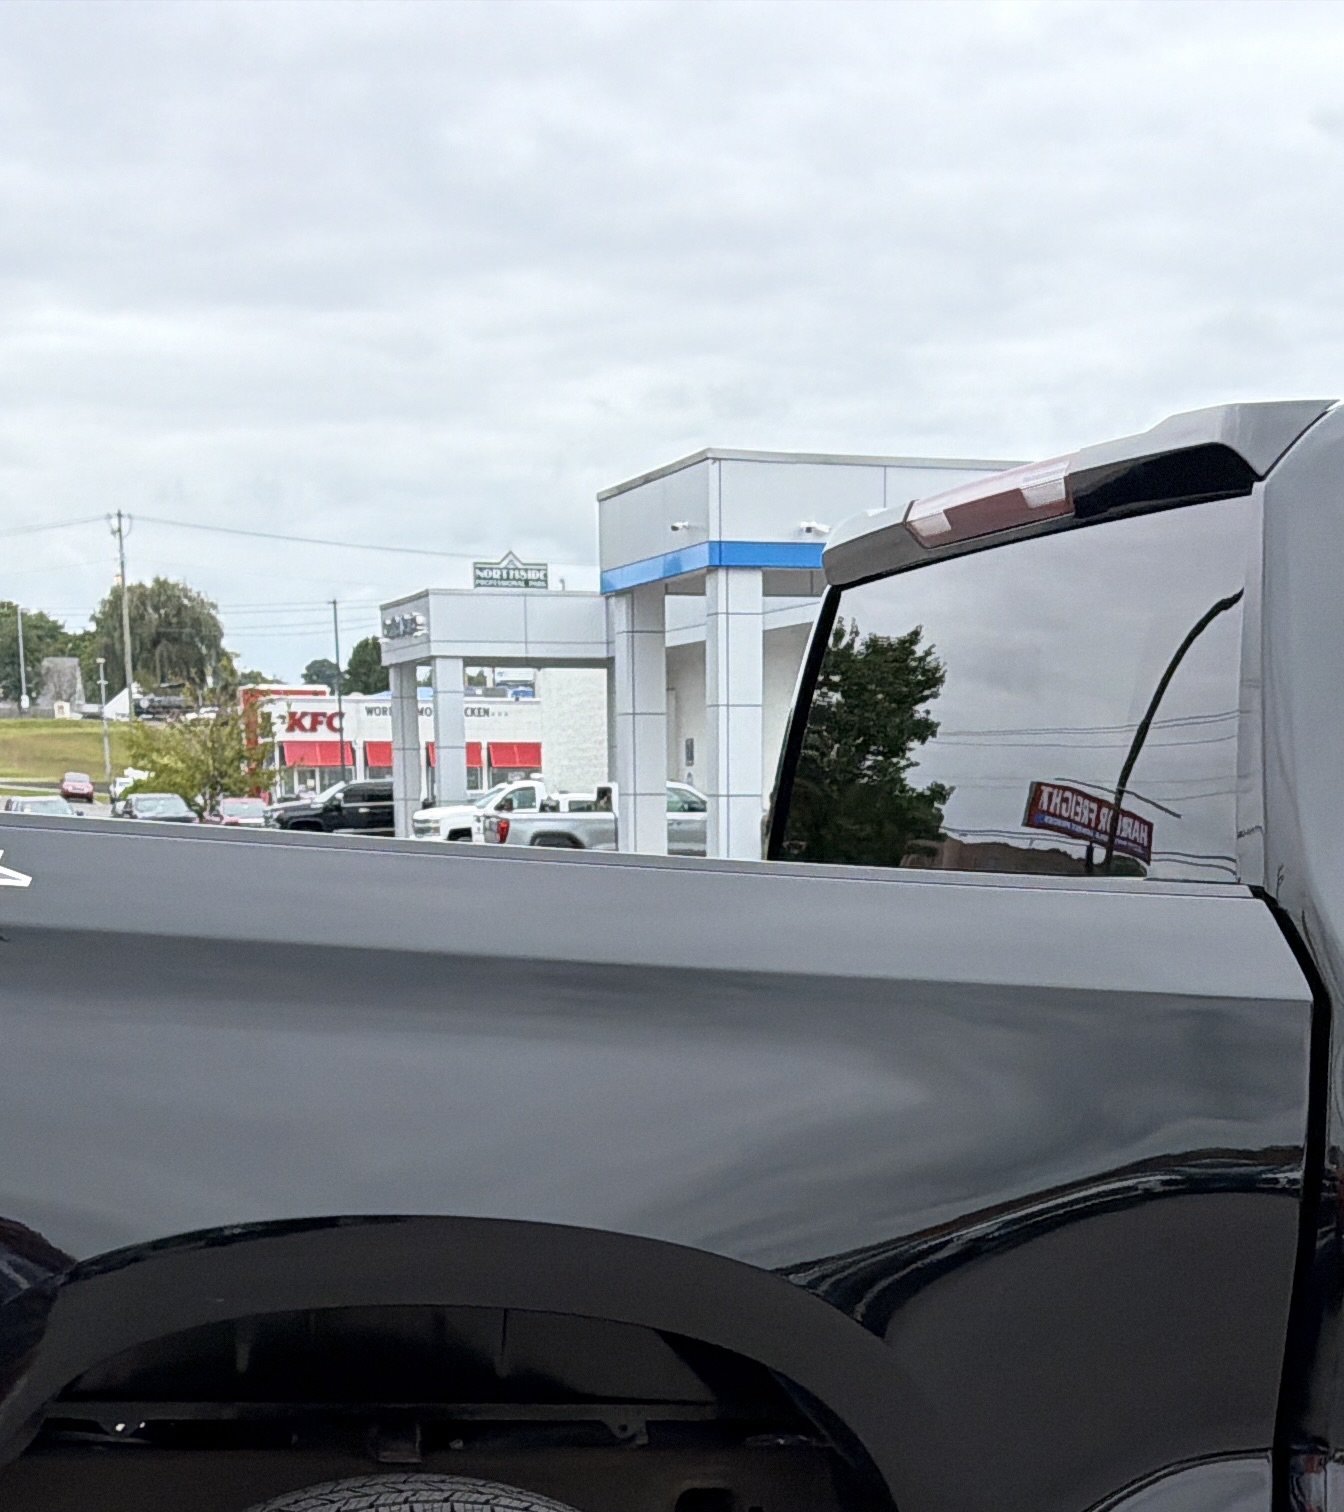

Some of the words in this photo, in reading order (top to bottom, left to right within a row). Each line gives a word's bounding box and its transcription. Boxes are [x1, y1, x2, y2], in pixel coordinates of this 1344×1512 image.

[476, 568, 547, 579] NORTHSIDE
[365, 705, 393, 717] WOR
[285, 711, 345, 733] KFC
